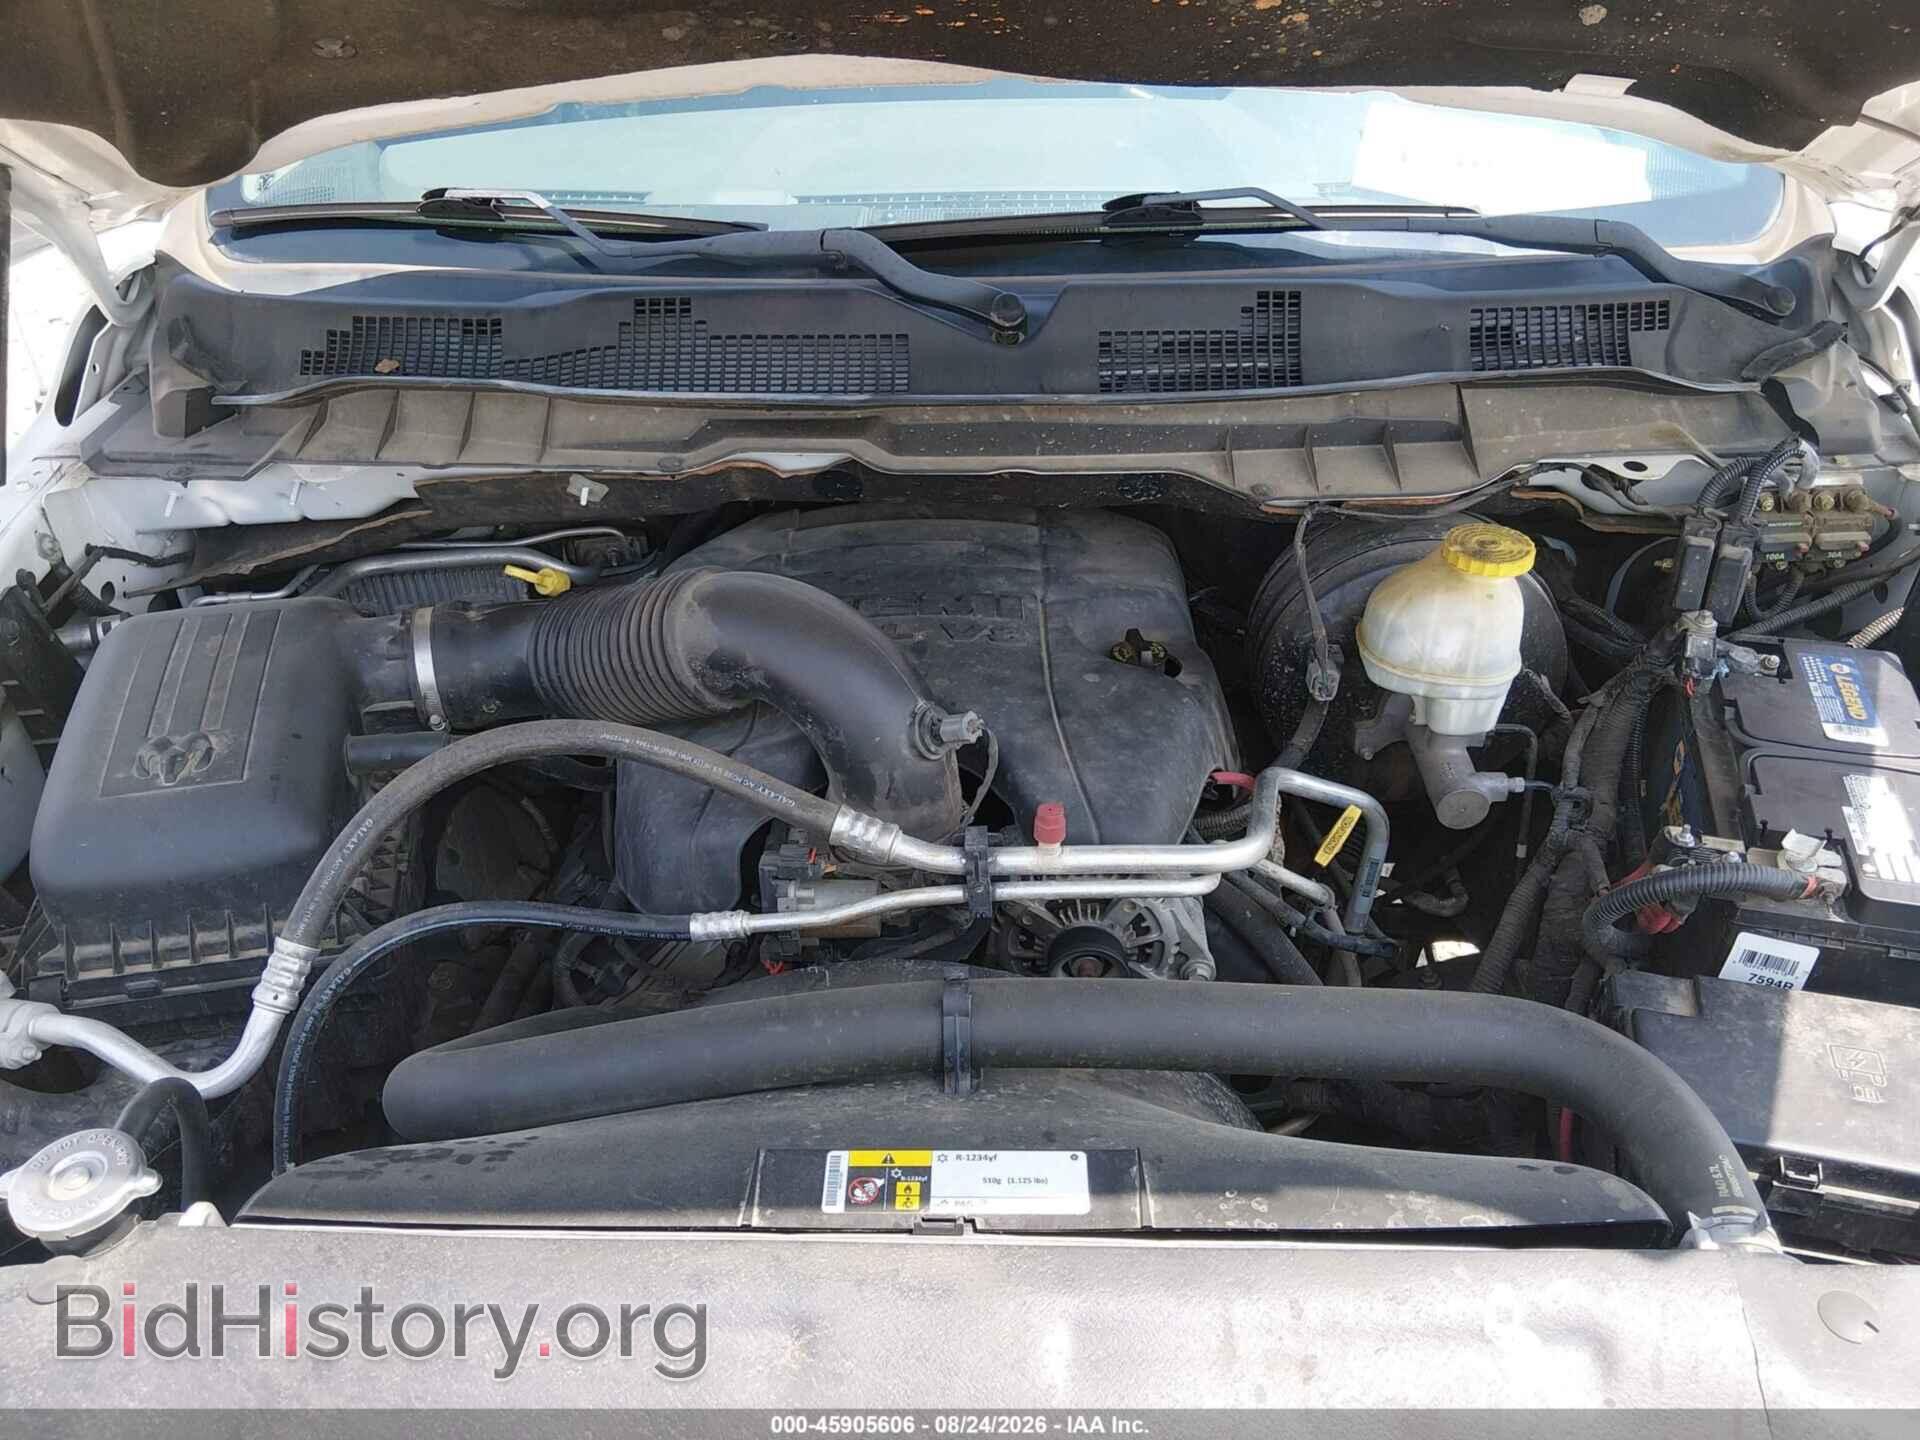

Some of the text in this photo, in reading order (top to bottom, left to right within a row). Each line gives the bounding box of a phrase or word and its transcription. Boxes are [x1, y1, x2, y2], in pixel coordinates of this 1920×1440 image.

[1835, 674, 1868, 720] LEGEND
[342, 817, 374, 856] GALAXY
[955, 1153, 998, 1163] R-1234yf
